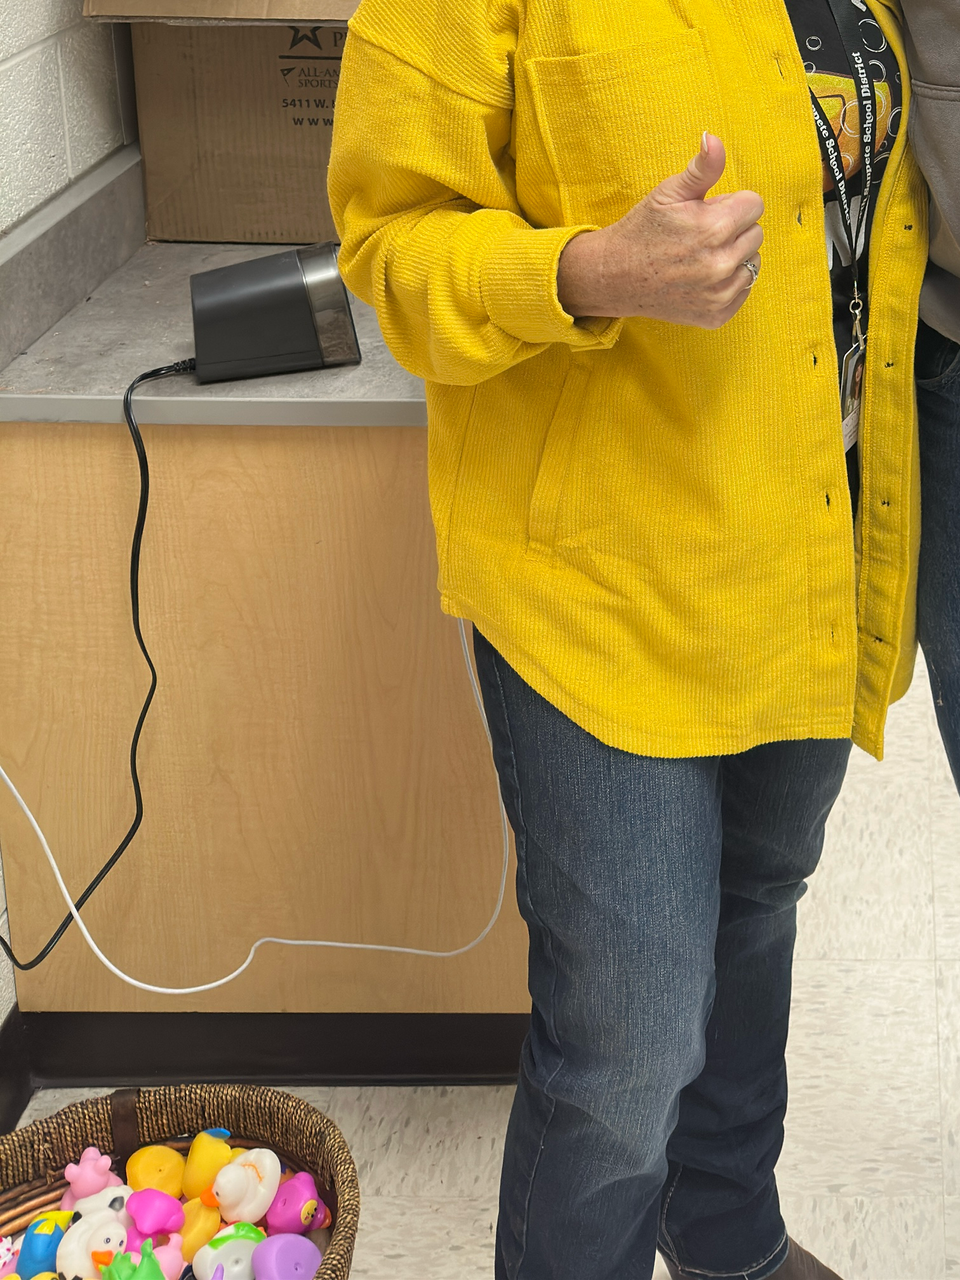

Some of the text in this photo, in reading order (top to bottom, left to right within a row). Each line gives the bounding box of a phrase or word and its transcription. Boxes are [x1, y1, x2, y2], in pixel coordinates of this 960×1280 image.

[852, 52, 871, 97] District
[282, 99, 311, 109] 5411
[863, 101, 873, 142] School
[825, 138, 843, 181] School
[838, 181, 852, 226] District
